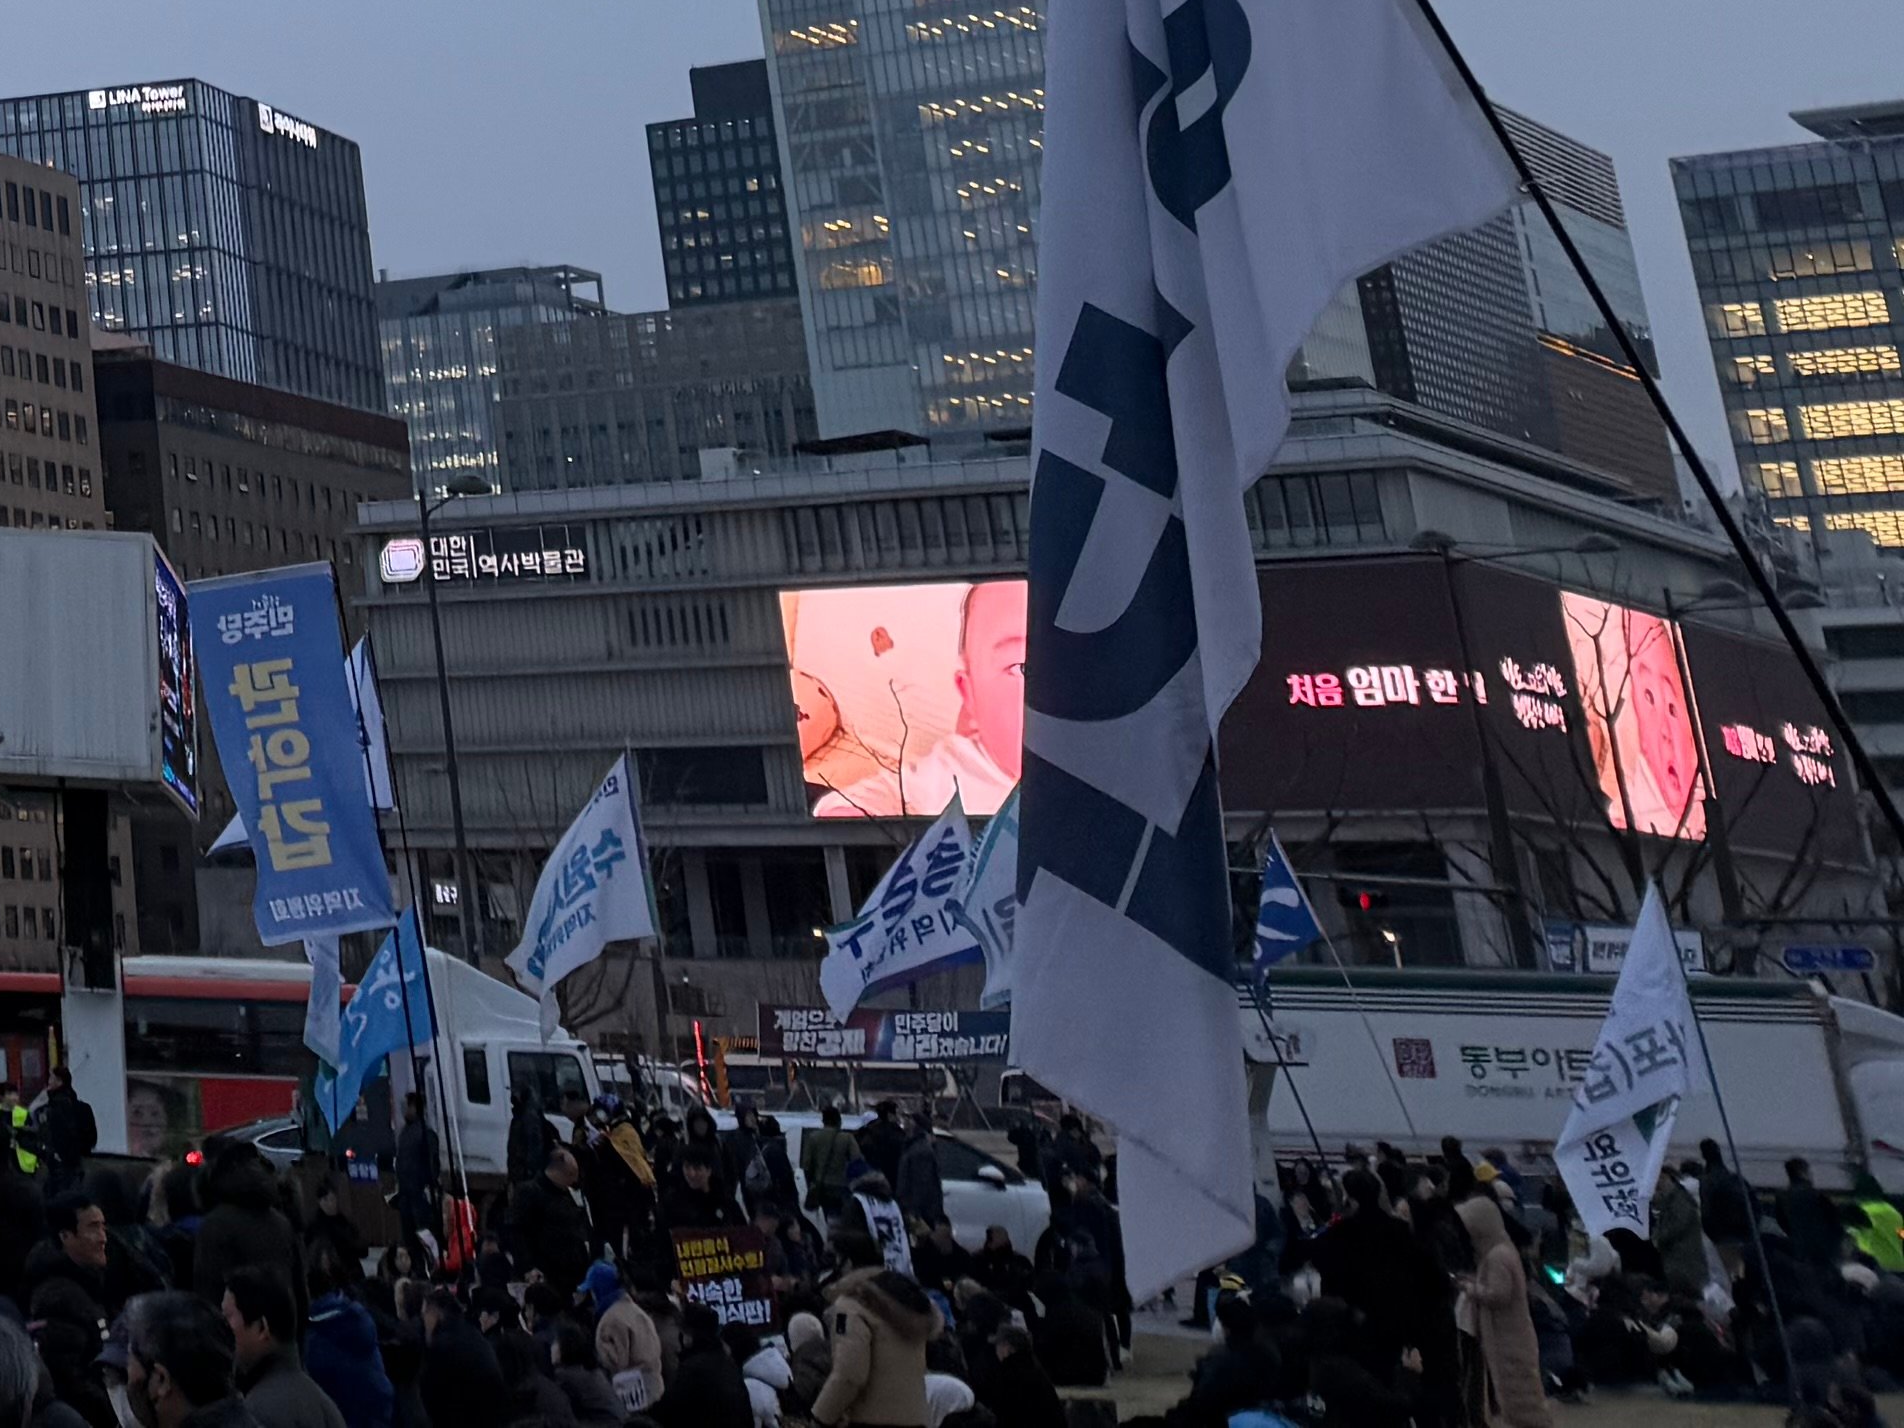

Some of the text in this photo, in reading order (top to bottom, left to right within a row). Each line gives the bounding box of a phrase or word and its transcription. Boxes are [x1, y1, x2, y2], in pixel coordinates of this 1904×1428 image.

[109, 86, 184, 105] LINA Tower
[430, 535, 466, 557] 대한
[431, 558, 470, 581] 민국
[478, 549, 586, 579] 역사박물관
[1286, 672, 1344, 707] 처음
[1346, 663, 1421, 707] 엄마
[894, 1011, 959, 1034] 민주당이
